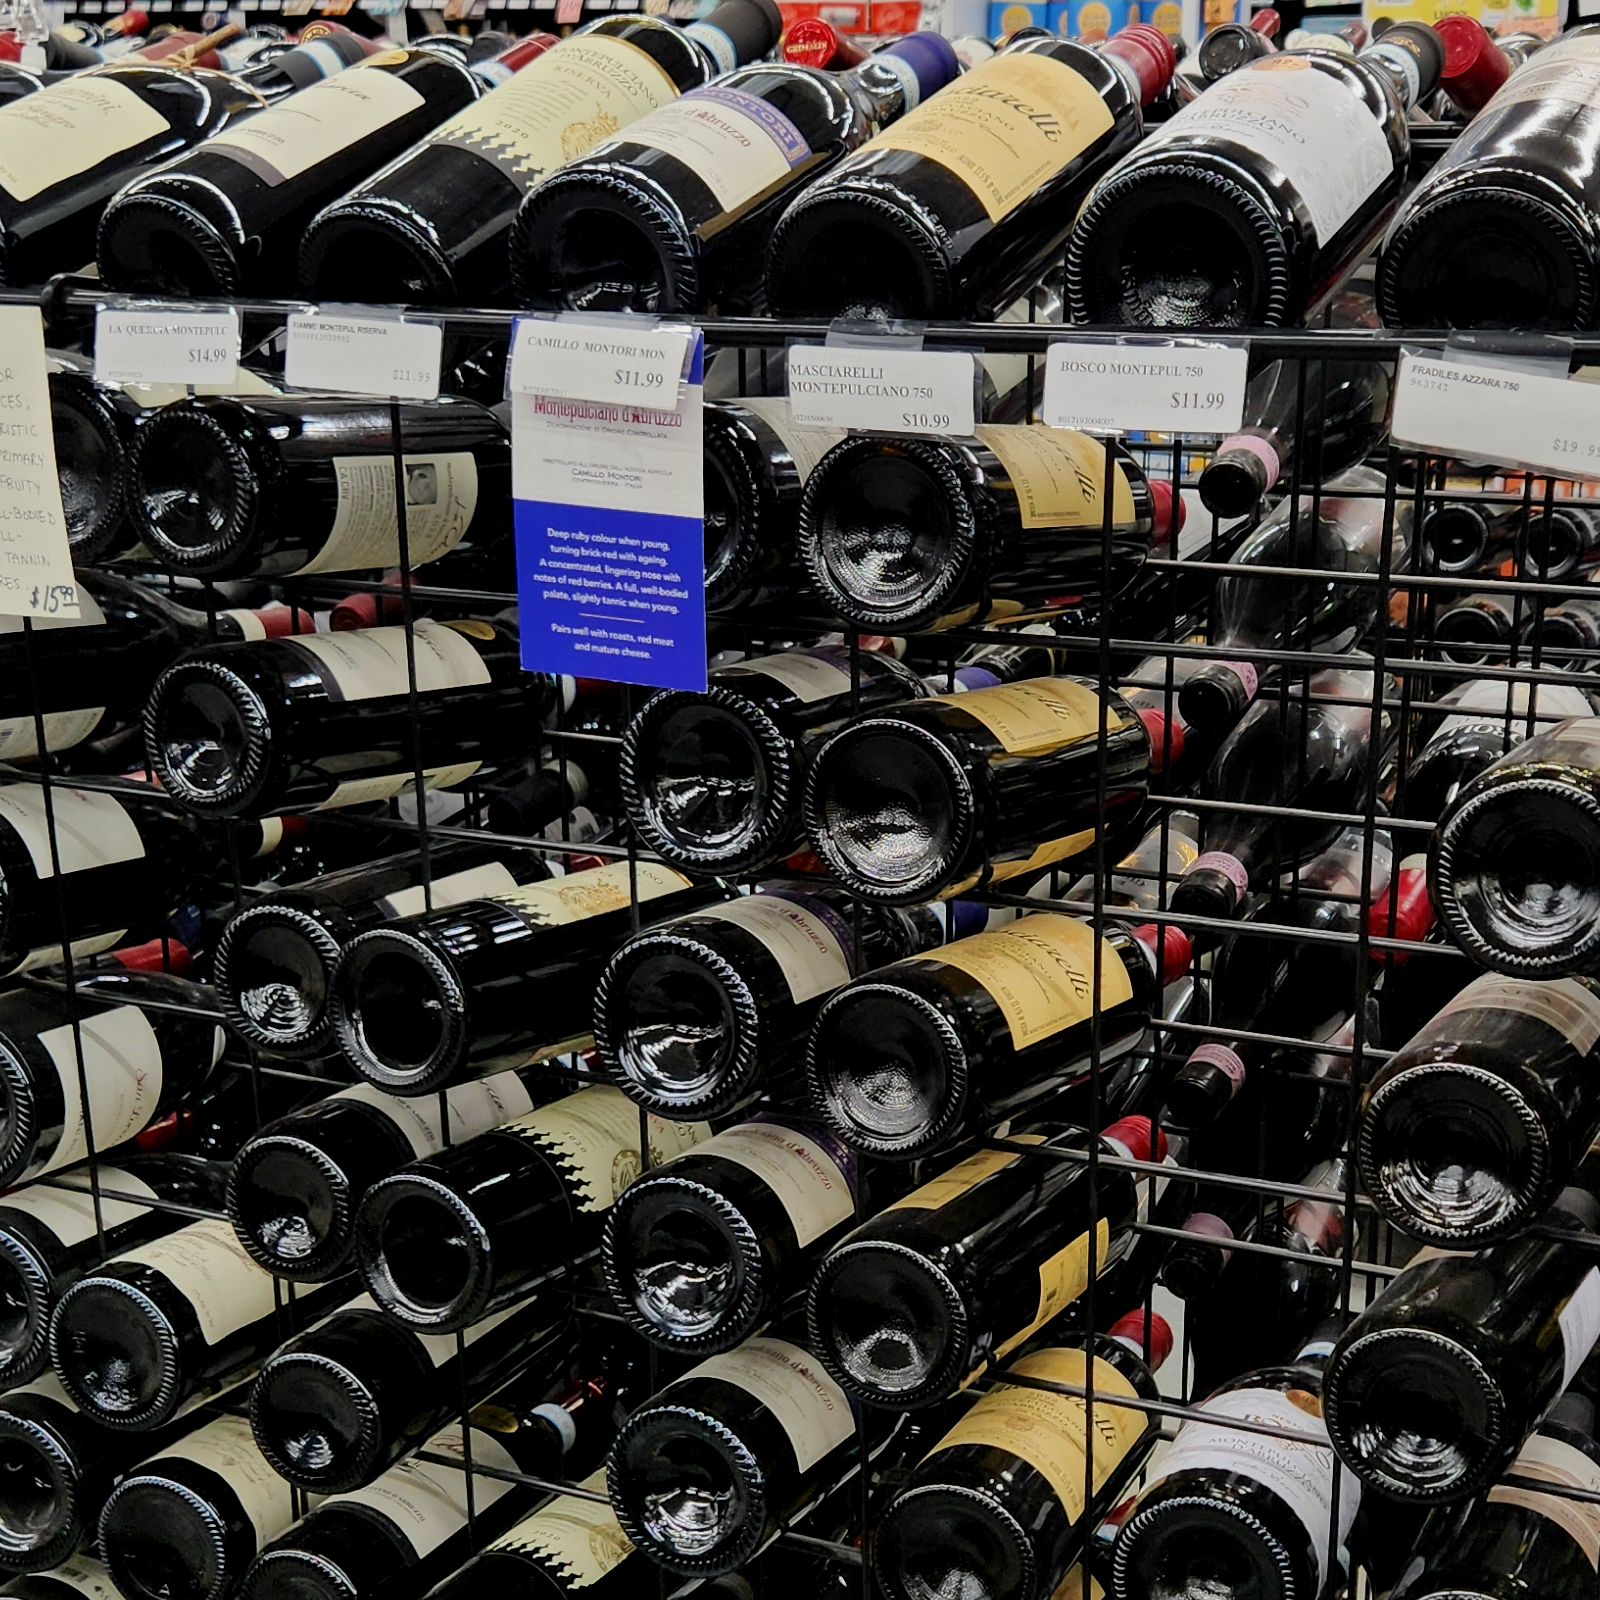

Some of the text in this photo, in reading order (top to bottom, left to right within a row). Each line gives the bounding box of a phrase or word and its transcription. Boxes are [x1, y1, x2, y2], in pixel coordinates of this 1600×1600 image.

[555, 65, 611, 98] RISERVA
[495, 121, 530, 139] 2020
[109, 325, 121, 334] LA
[293, 322, 388, 336] FIAMME MONTEPUL RISERVA
[188, 348, 227, 363] $14.99
[528, 336, 667, 360] CAMILLO MONTORI MON
[393, 369, 431, 383] $11.99
[790, 364, 885, 380] MASCIARELLI
[1061, 361, 1204, 378] BOSCO MONTEPUL 750
[1411, 365, 1520, 392] FRADILES AZZARA 750
[614, 369, 664, 389] $11.99
[1410, 377, 1449, 392] 963741
[790, 381, 933, 399] MONTEPULCIANO 750
[1171, 392, 1225, 409] $11.99
[902, 413, 950, 428] $10.99
[547, 527, 571, 541] Deep
[571, 531, 590, 543] ruby
[591, 533, 617, 544] colour
[618, 536, 640, 546] when
[4, 552, 51, 567] TANNIN
[550, 544, 669, 567] turning brick-red with ageing.
[539, 558, 681, 582] A concentrated, lingering nose with
[533, 574, 689, 599] notes of red berries. A full, well-bodied
[543, 589, 680, 615] palate, slightly tannic when young.
[551, 623, 675, 647] Pairs well with roasts, red meat
[574, 642, 652, 659] and mature cheese.
